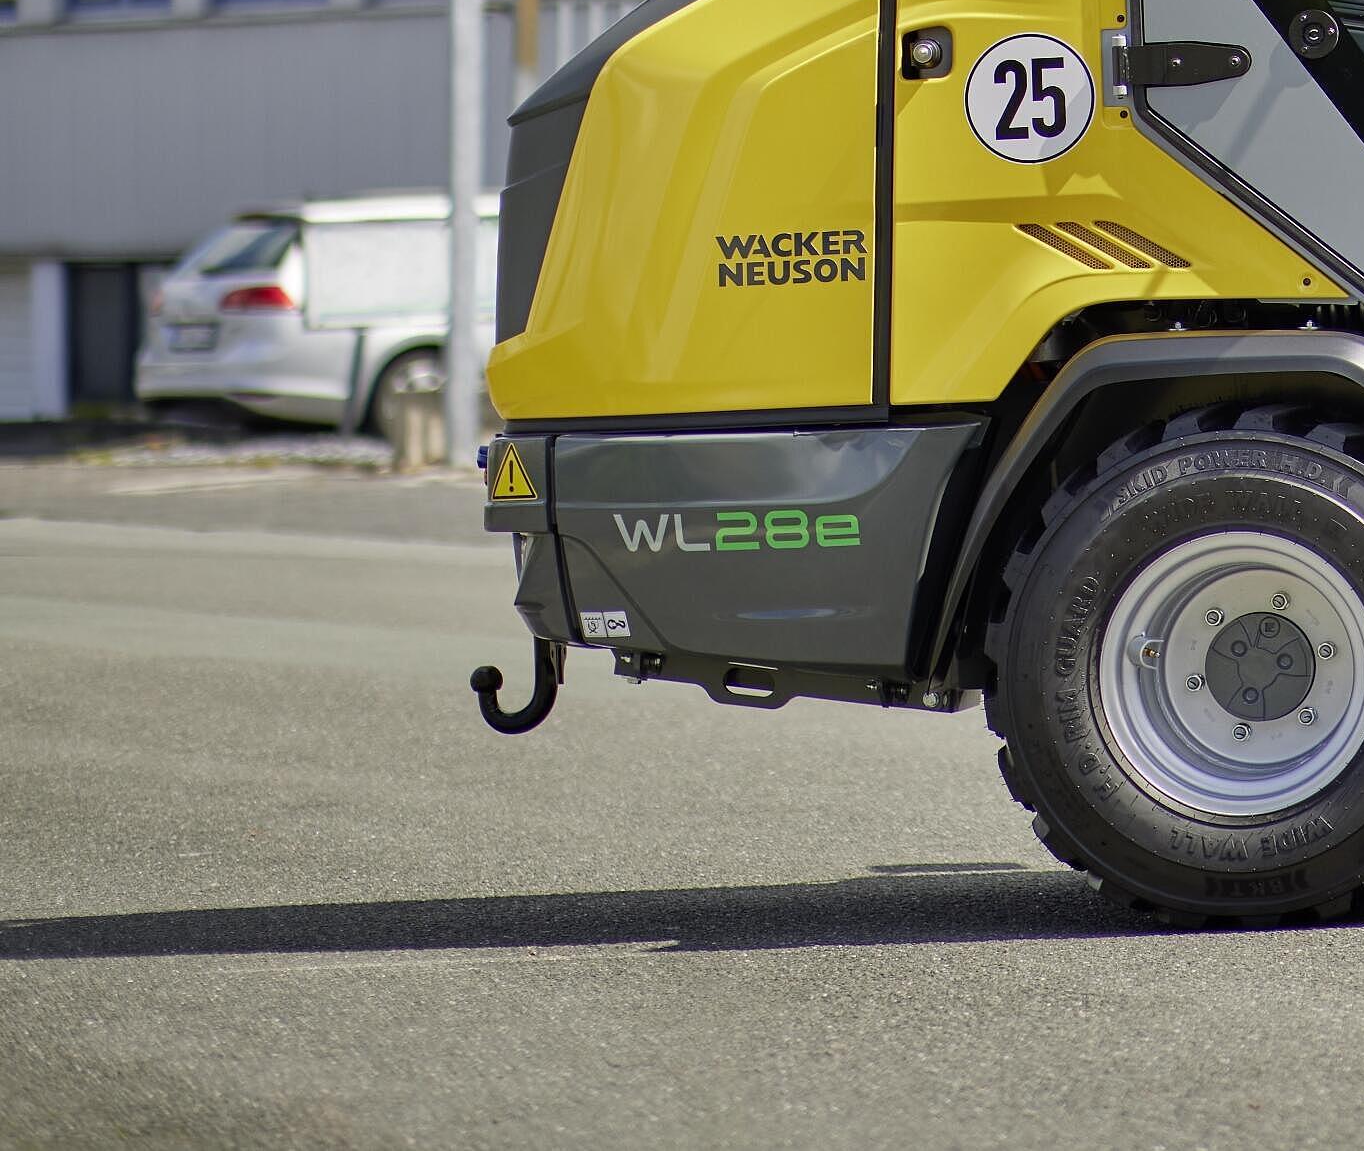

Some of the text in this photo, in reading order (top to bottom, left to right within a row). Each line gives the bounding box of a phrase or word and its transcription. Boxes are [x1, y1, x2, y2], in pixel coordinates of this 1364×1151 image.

[993, 56, 1067, 141] 25
[715, 229, 868, 259] WACKER
[718, 257, 866, 287] NEUSON
[1116, 463, 1169, 505] SKID
[1176, 448, 1268, 475] POWER
[612, 509, 861, 552] WL28e
[1169, 814, 1336, 862] WIDE WALL
